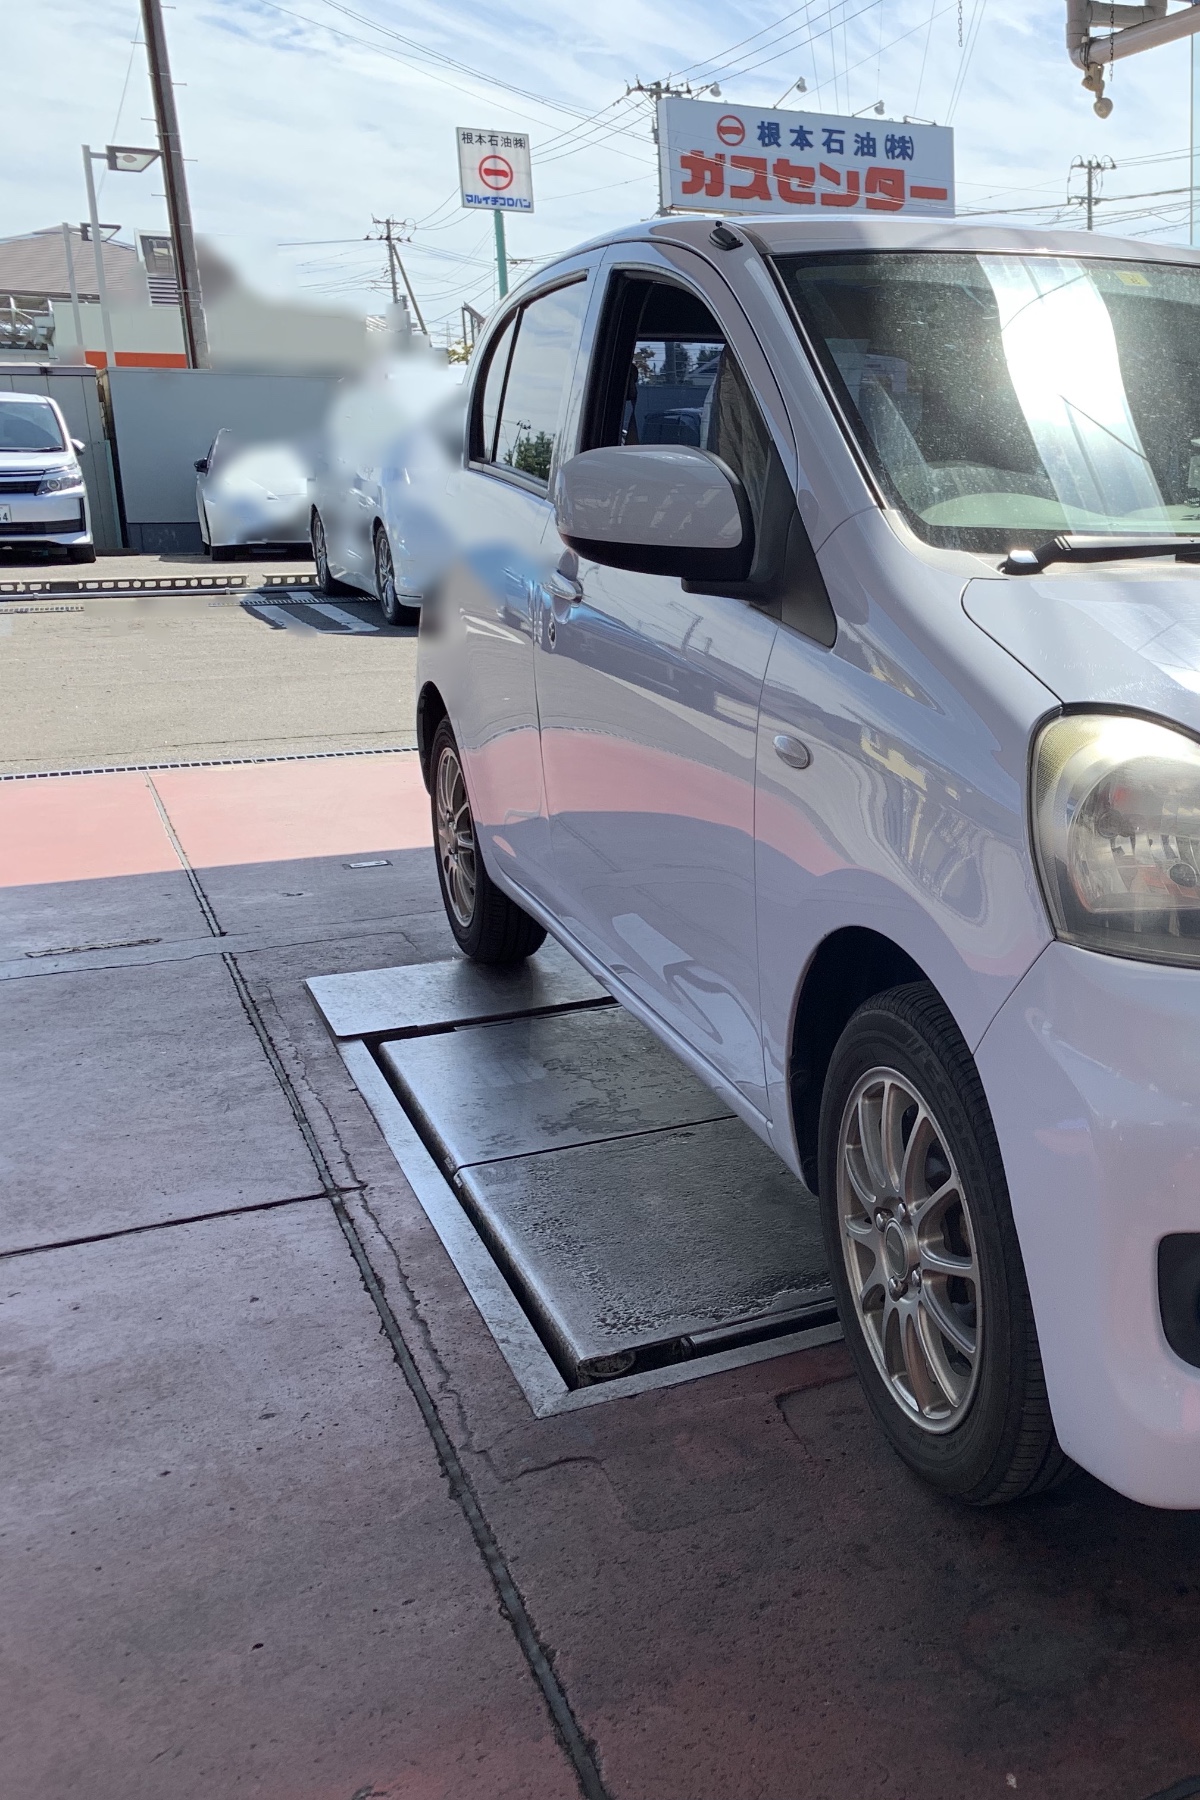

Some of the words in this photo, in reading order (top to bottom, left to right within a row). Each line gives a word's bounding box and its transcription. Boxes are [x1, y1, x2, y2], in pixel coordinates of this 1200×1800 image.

[680, 150, 947, 211] ガスセンター
